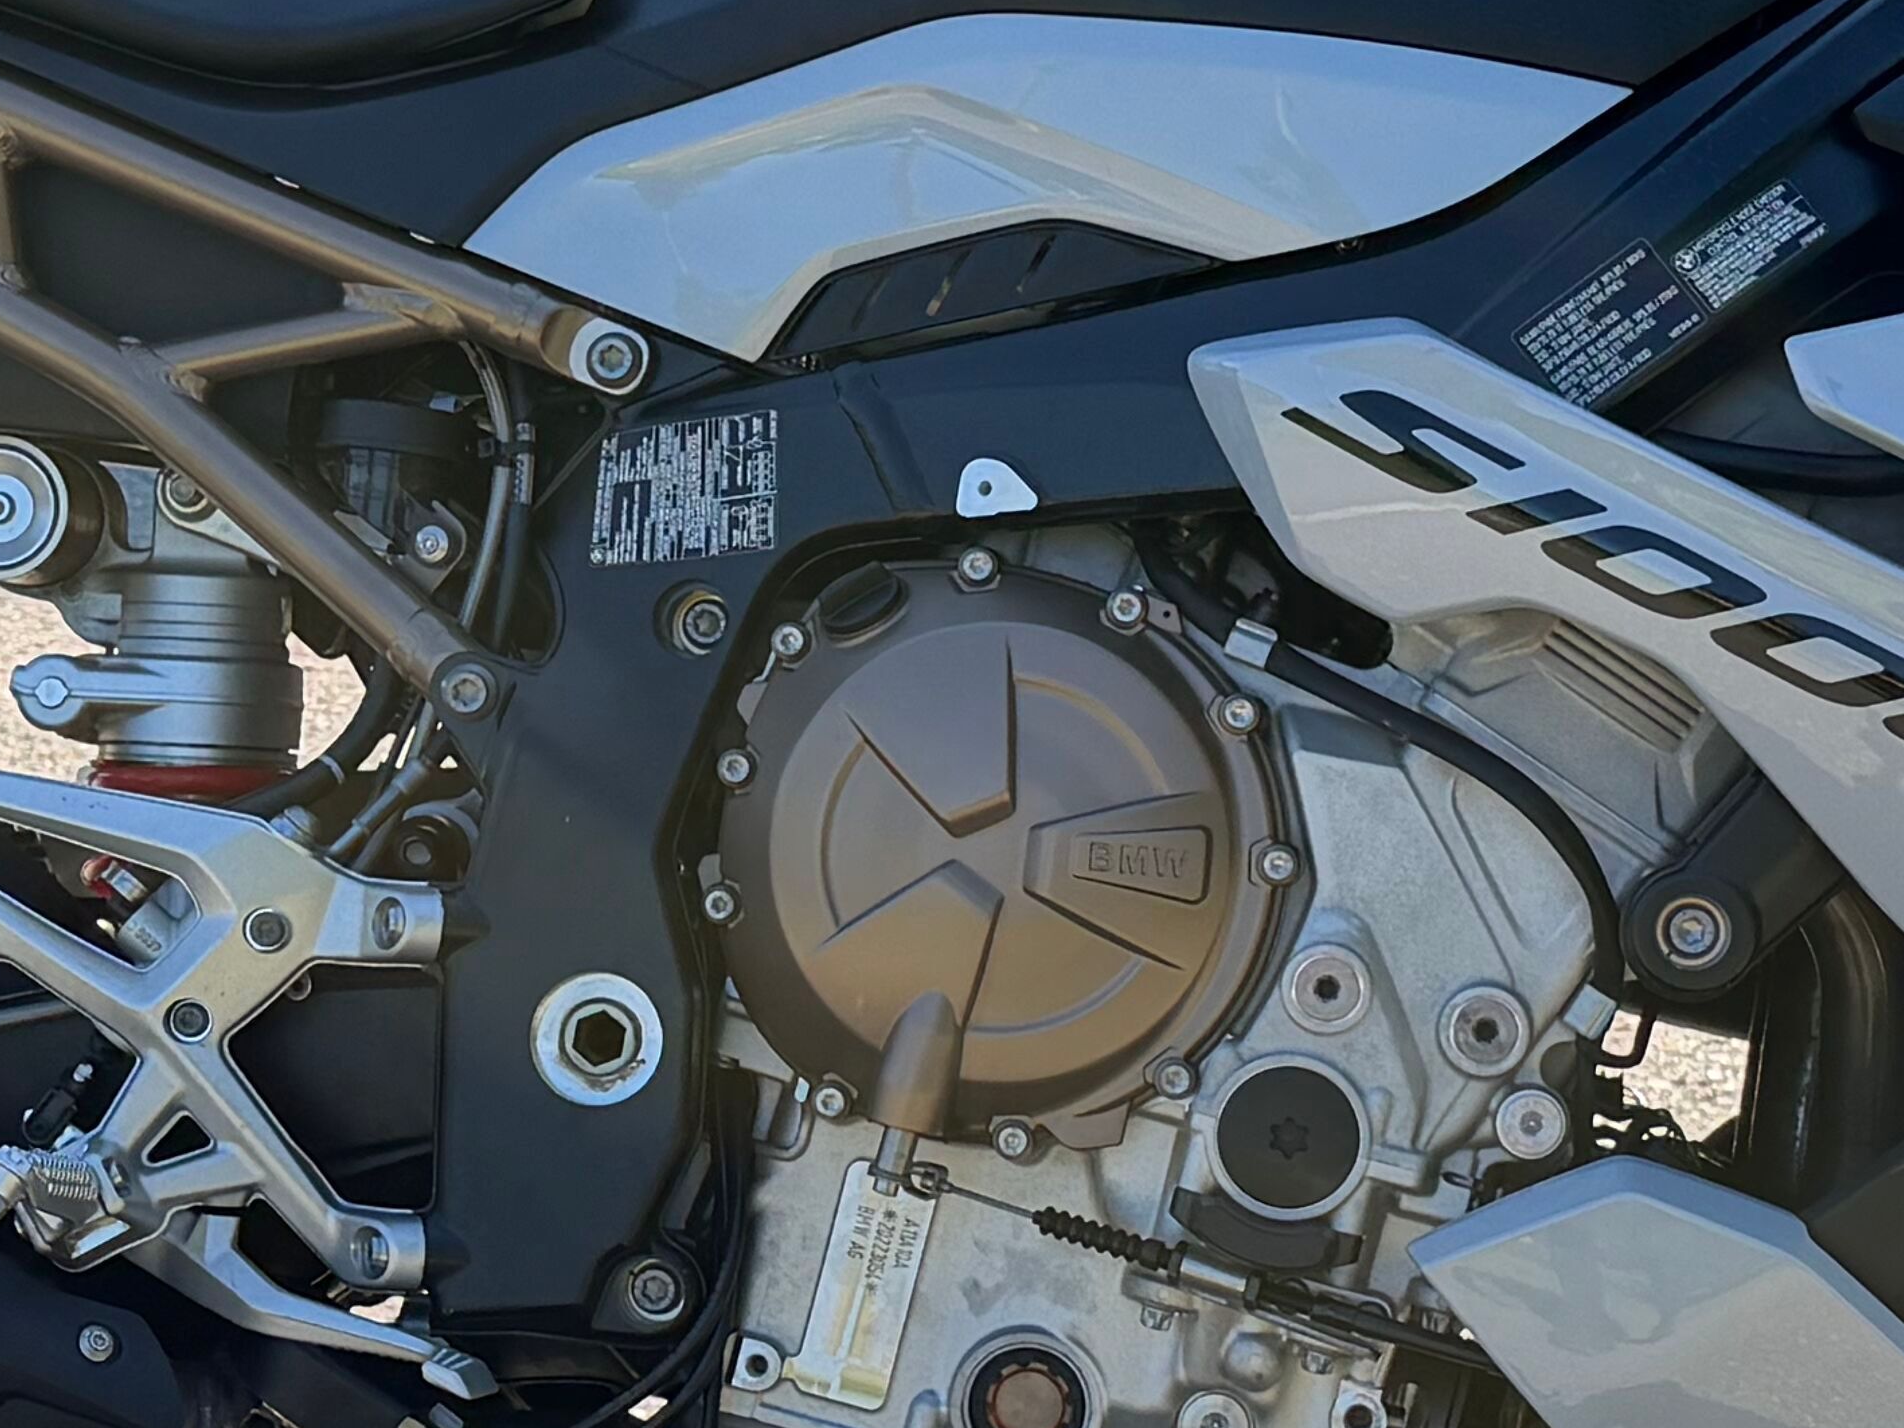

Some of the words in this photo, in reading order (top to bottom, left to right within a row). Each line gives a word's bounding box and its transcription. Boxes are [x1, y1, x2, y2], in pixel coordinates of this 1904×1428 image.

[1087, 839, 1190, 879] BMW
[852, 1204, 876, 1240] BMW
[846, 1239, 865, 1260] AG
